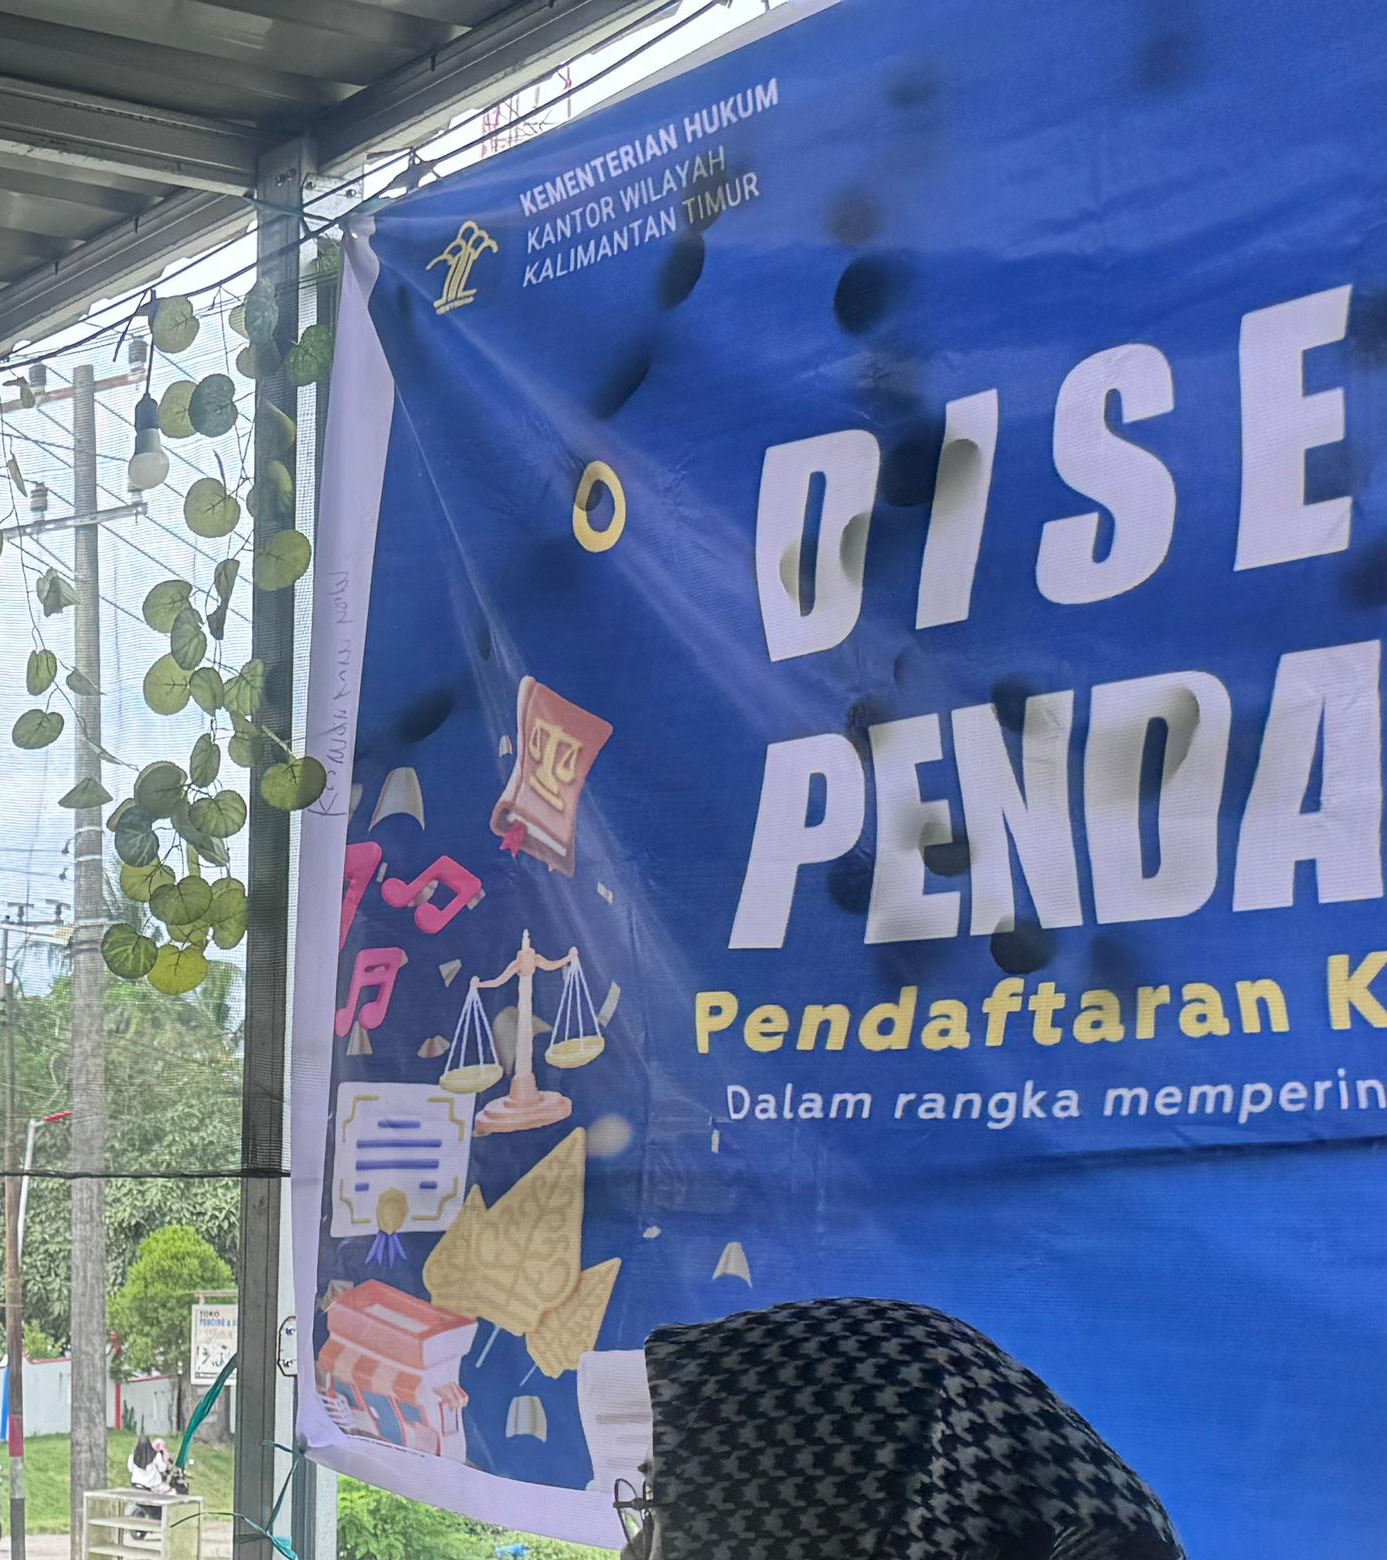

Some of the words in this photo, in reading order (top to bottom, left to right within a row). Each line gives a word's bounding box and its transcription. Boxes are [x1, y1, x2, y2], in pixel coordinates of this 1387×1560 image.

[519, 124, 678, 217] KEMENTERIAN
[683, 78, 779, 143] HUKUM
[527, 196, 616, 254] KANTOR
[620, 145, 725, 212] WILAYAH
[522, 206, 677, 287] KALIMANTAN
[682, 172, 760, 224] TIMUR
[754, 283, 1353, 662] DISE
[727, 639, 1384, 949] PENDA
[695, 976, 1290, 1054] Pendaftaran
[727, 1082, 873, 1120] Dalam
[894, 1080, 1081, 1130] rangka
[1103, 1067, 1387, 1125] memperin
